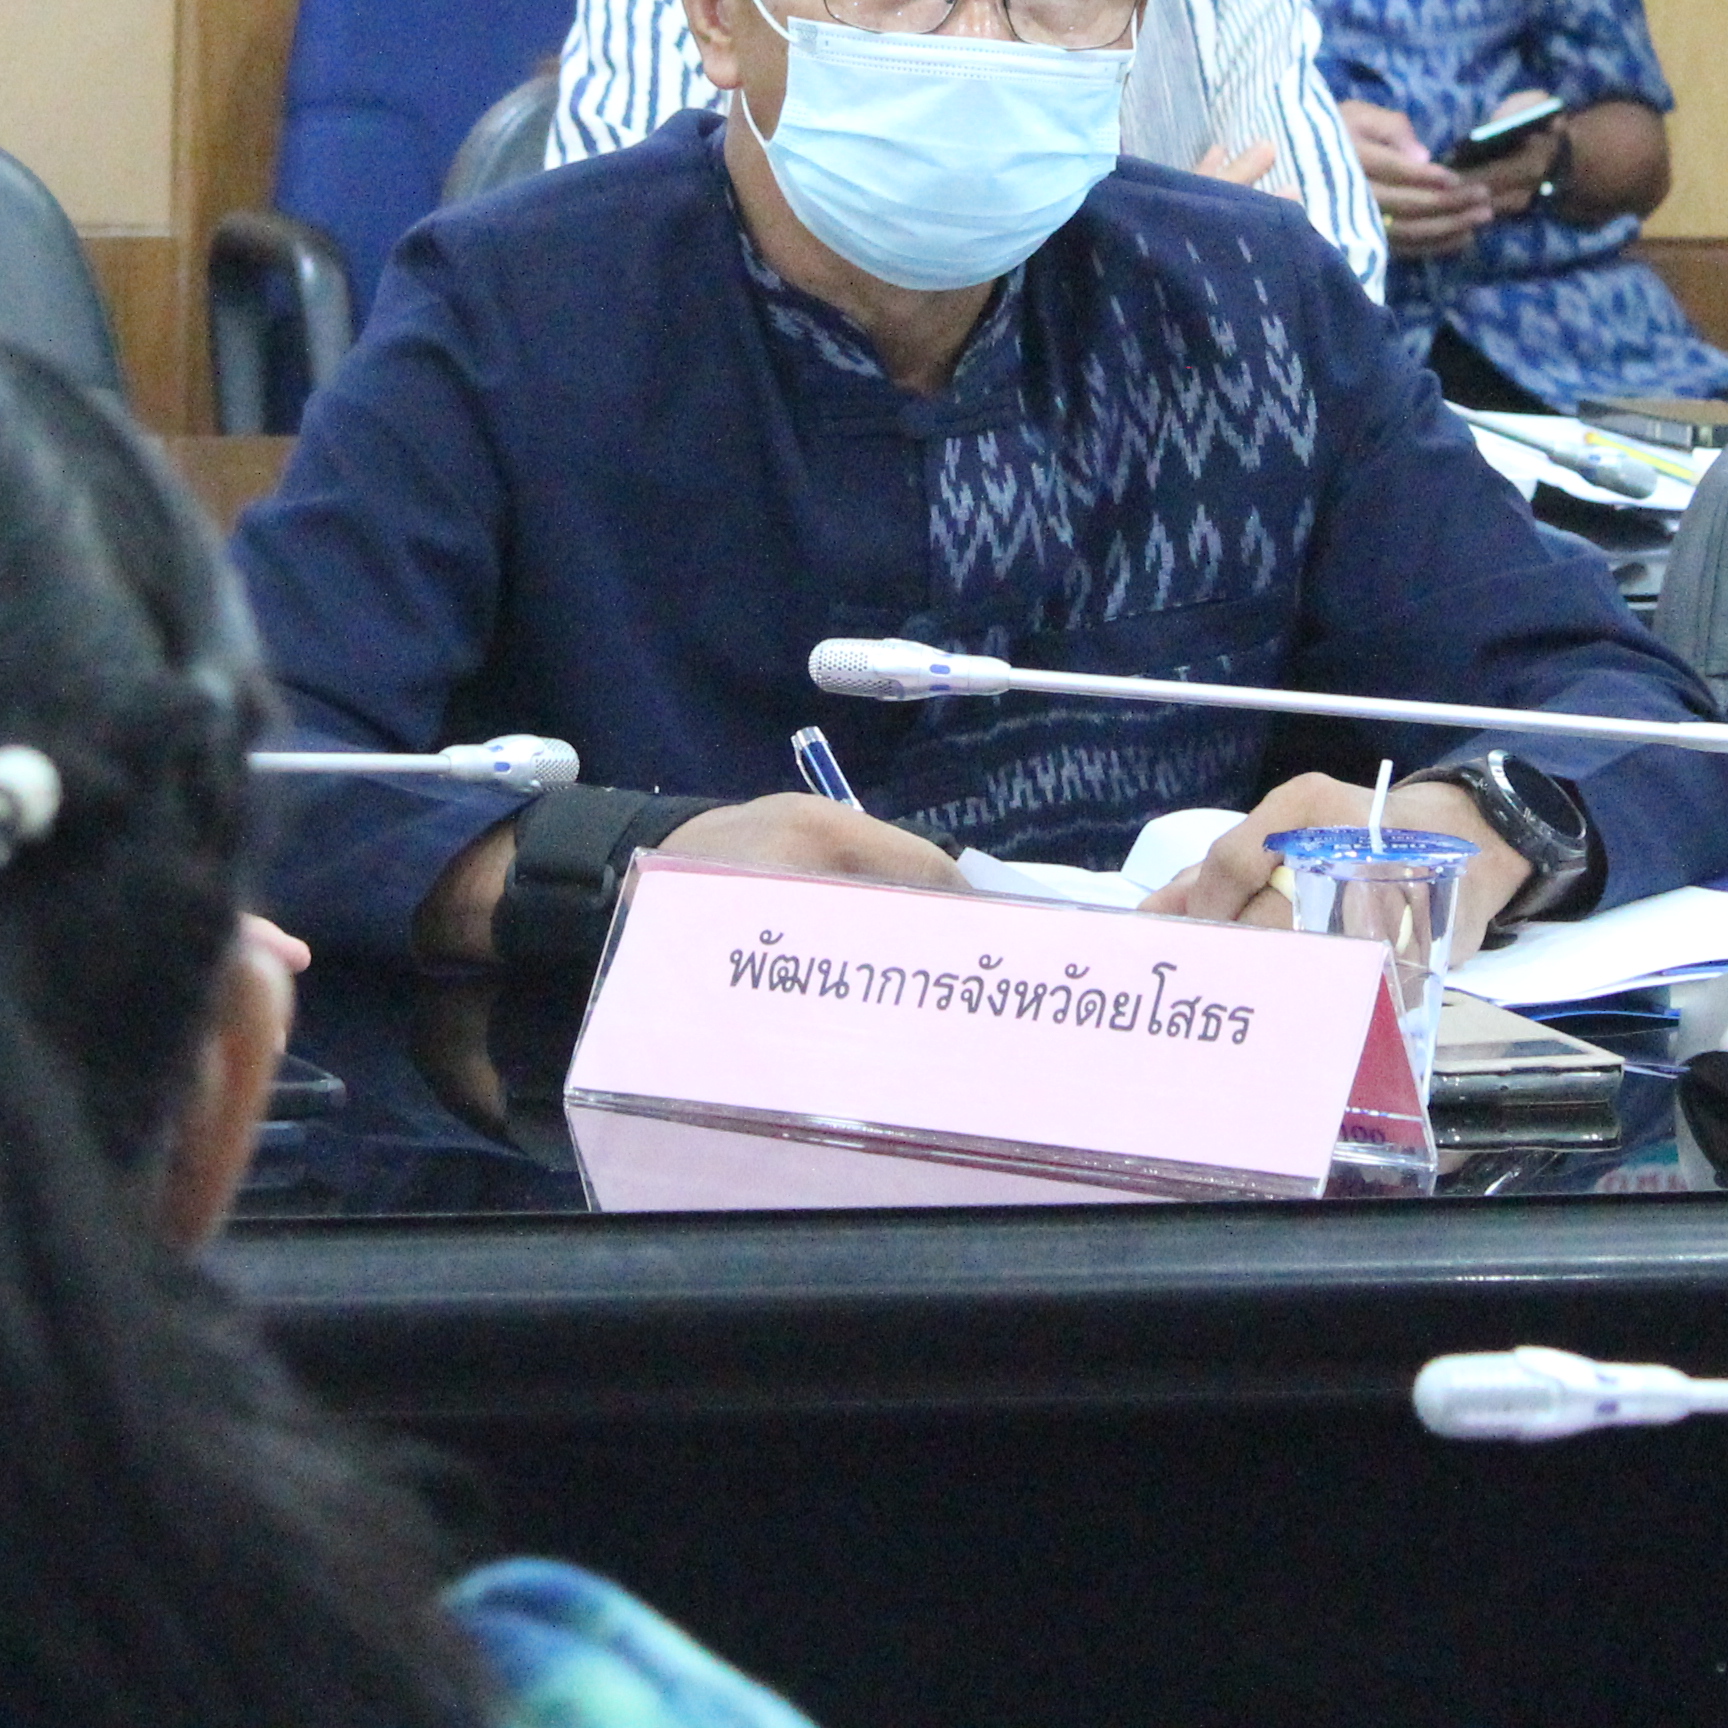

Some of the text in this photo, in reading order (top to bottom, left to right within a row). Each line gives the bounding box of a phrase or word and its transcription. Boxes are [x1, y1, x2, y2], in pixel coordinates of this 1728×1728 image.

[728, 929, 1255, 1047] พัฒนาการจังหวัดยโสธร
